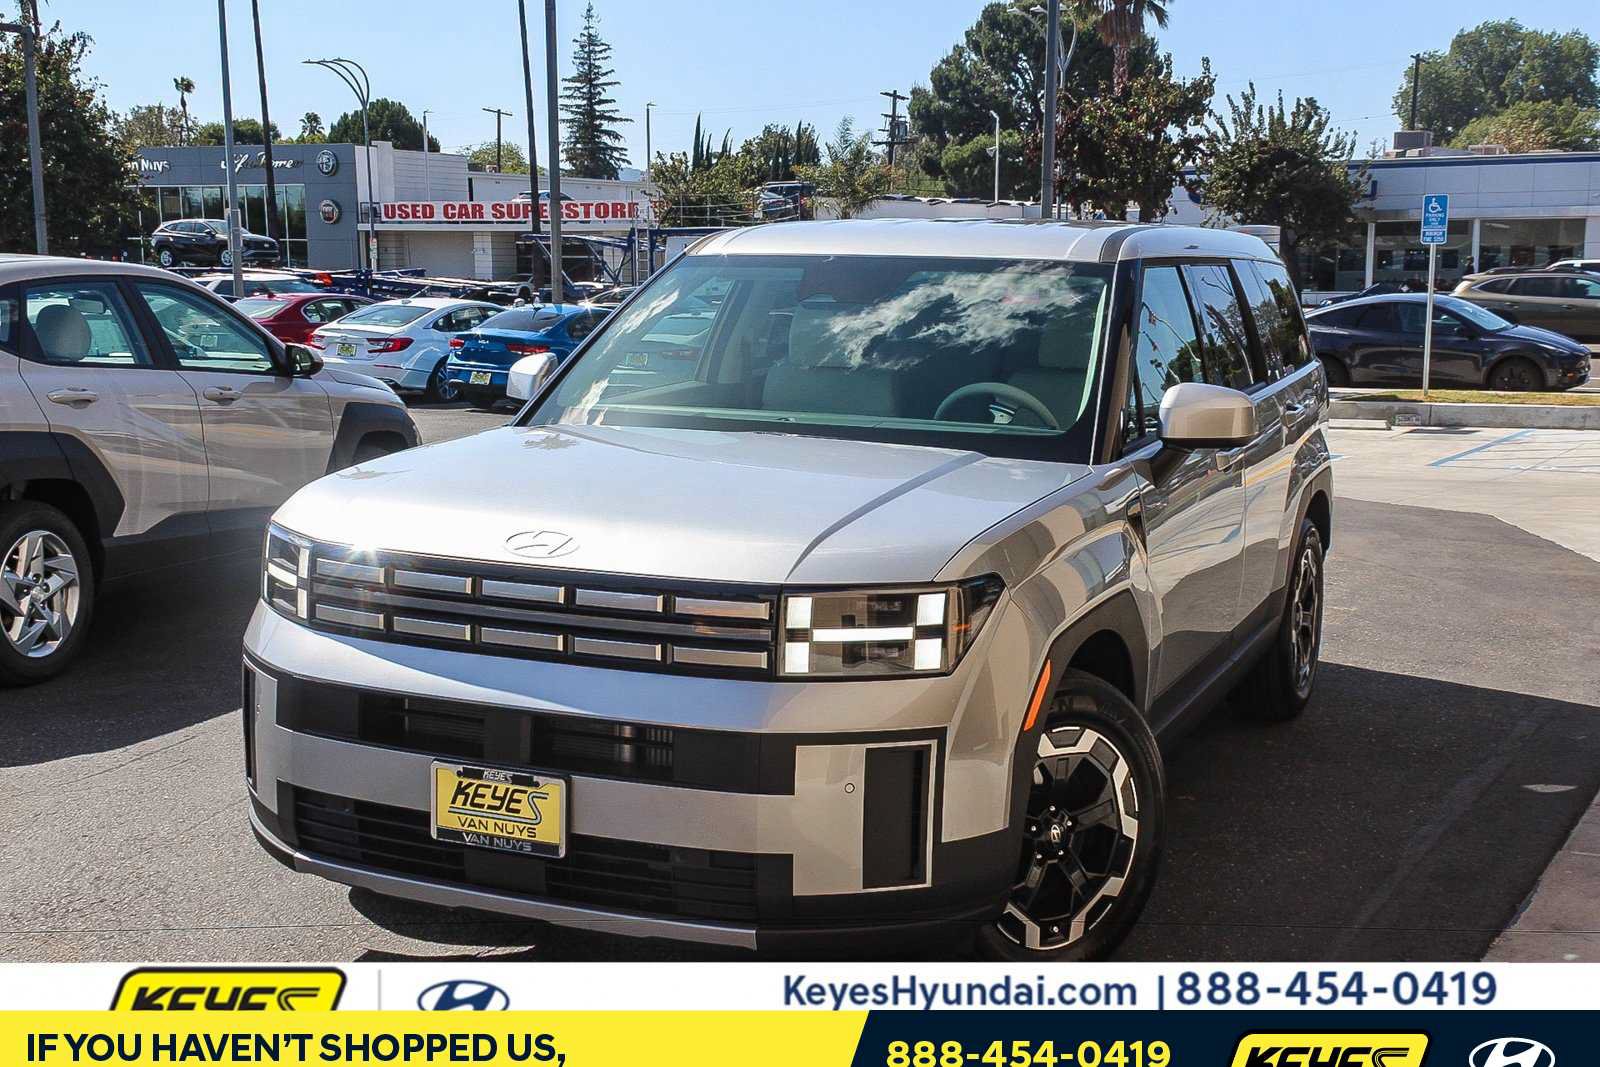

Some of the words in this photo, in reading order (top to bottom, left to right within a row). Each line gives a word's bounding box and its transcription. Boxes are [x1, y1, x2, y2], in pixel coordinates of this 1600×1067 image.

[141, 158, 170, 172] Nuys
[383, 203, 435, 219] USED
[442, 203, 484, 219] CAR
[482, 769, 513, 783] KEYES
[448, 780, 549, 824] KEYES
[457, 816, 488, 831] VAN
[493, 821, 537, 838] NUYS
[462, 832, 490, 846] VAN
[493, 836, 533, 851] NUYS
